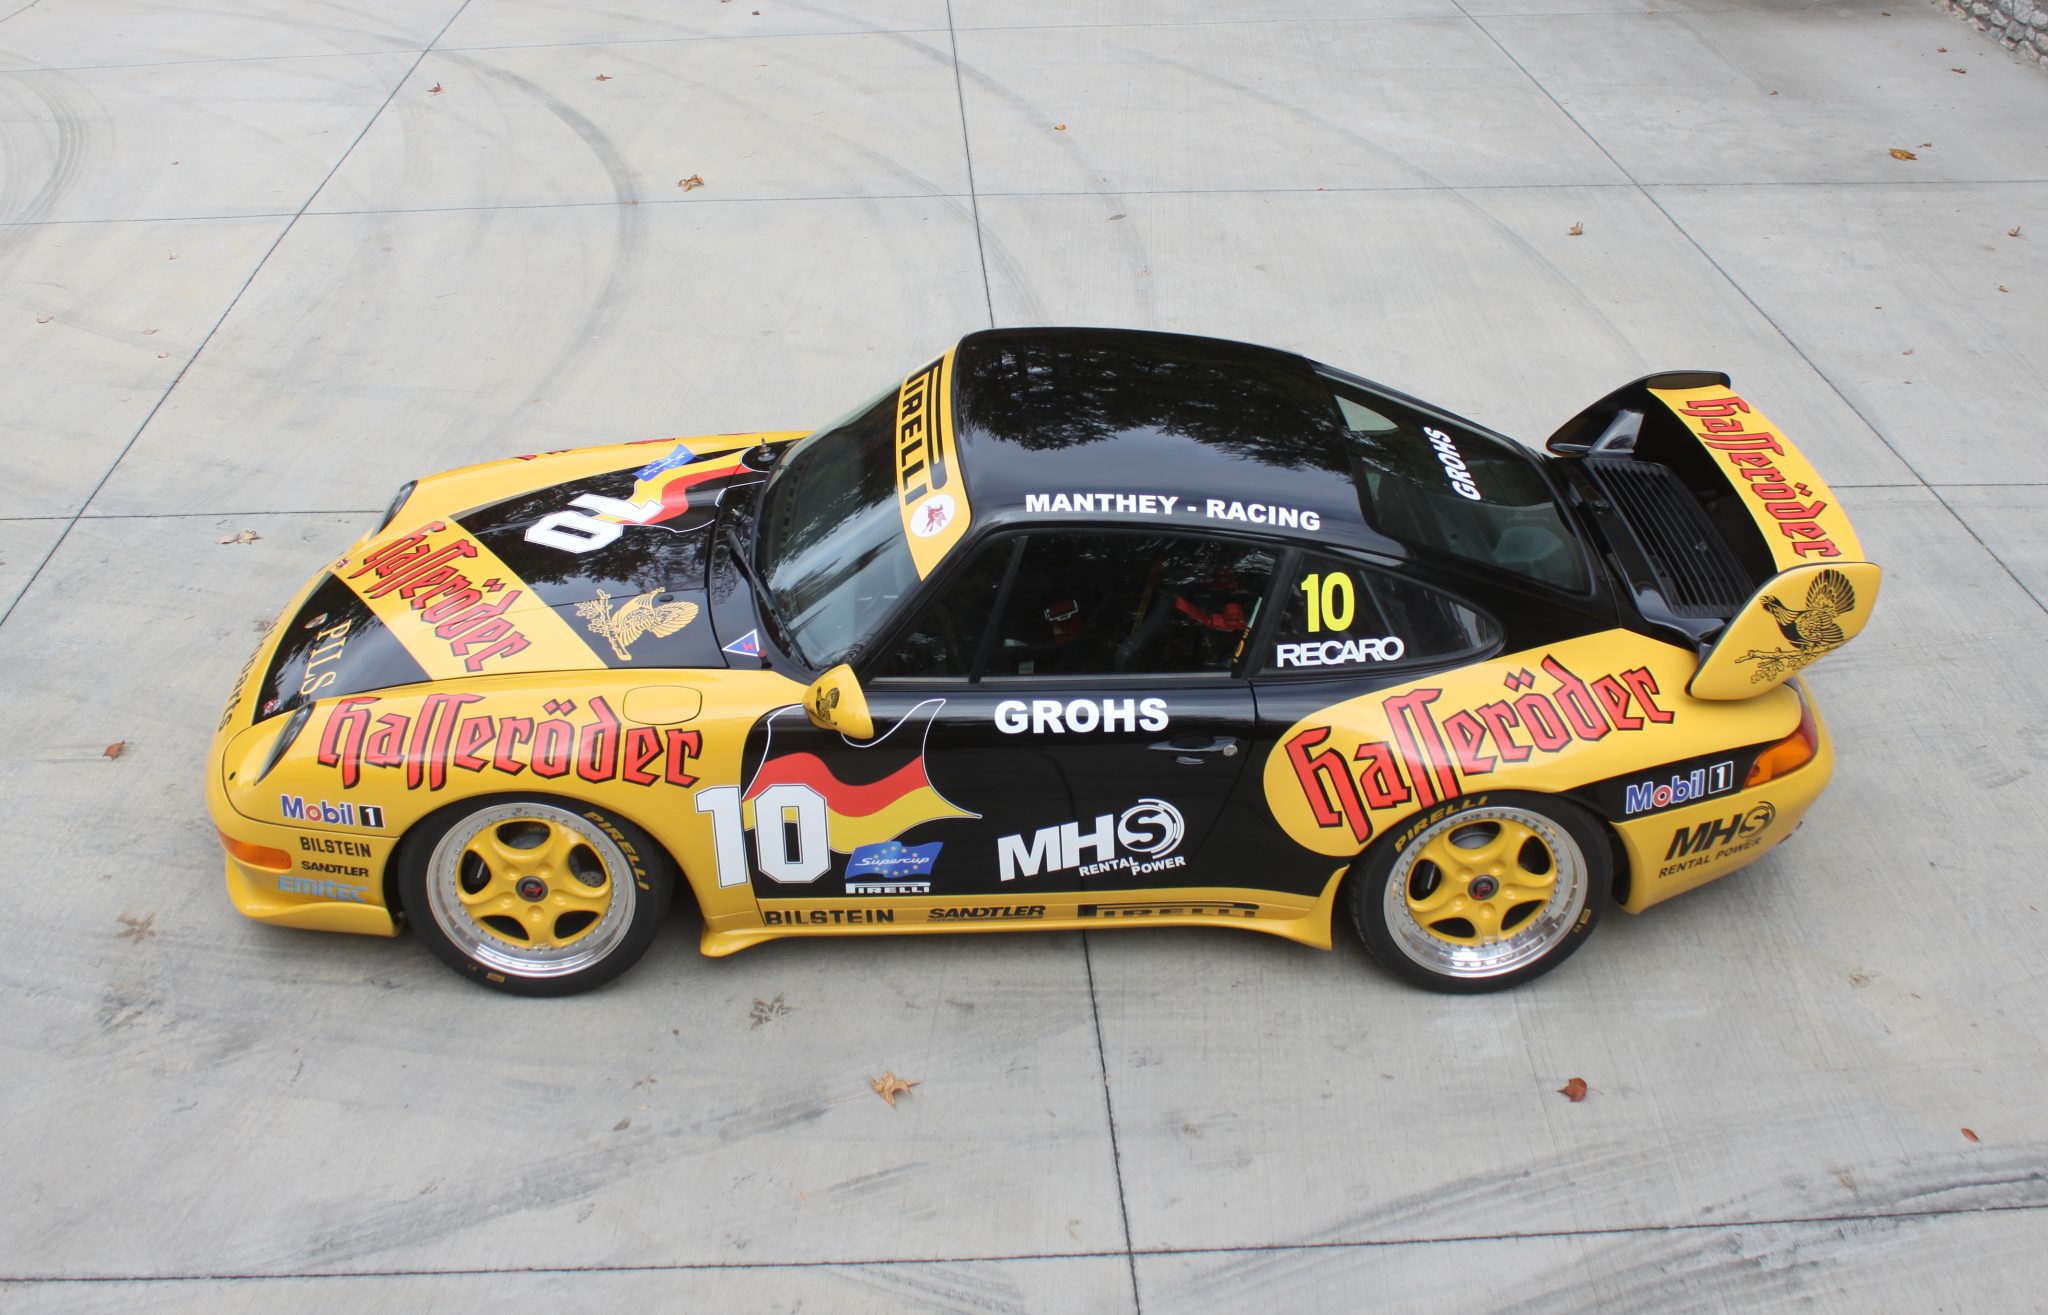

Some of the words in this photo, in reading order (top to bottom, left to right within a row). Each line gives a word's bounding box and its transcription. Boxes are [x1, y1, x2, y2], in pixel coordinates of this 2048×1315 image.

[901, 355, 948, 506] PIRELLI
[1424, 426, 1482, 501] GROHS
[523, 493, 665, 554] 10
[1025, 493, 1178, 515] MANTHEY
[1206, 499, 1321, 530] RACING
[1301, 572, 1355, 632] 10
[300, 619, 353, 695] PILS
[1276, 636, 1405, 668] RECARO
[994, 697, 1169, 734] GROHS
[280, 793, 355, 826] Mobil
[1625, 769, 1705, 814] Mobil
[694, 783, 831, 889] 10
[997, 798, 1185, 882] MHS
[1393, 795, 1489, 853] PIRELLI
[300, 836, 372, 858] BILSTEIN
[583, 811, 650, 891] PIRELLI
[855, 857, 930, 867] Supercup
[1079, 857, 1139, 877] RENTAL
[1131, 856, 1187, 876] POWER
[1658, 853, 1711, 879] RENTAL
[1715, 837, 1763, 860] POWER
[301, 860, 369, 877] SANDTLER
[845, 882, 931, 894] PIRELLI
[764, 909, 894, 925] BILSTEIN
[927, 905, 1046, 919] SANDTLER
